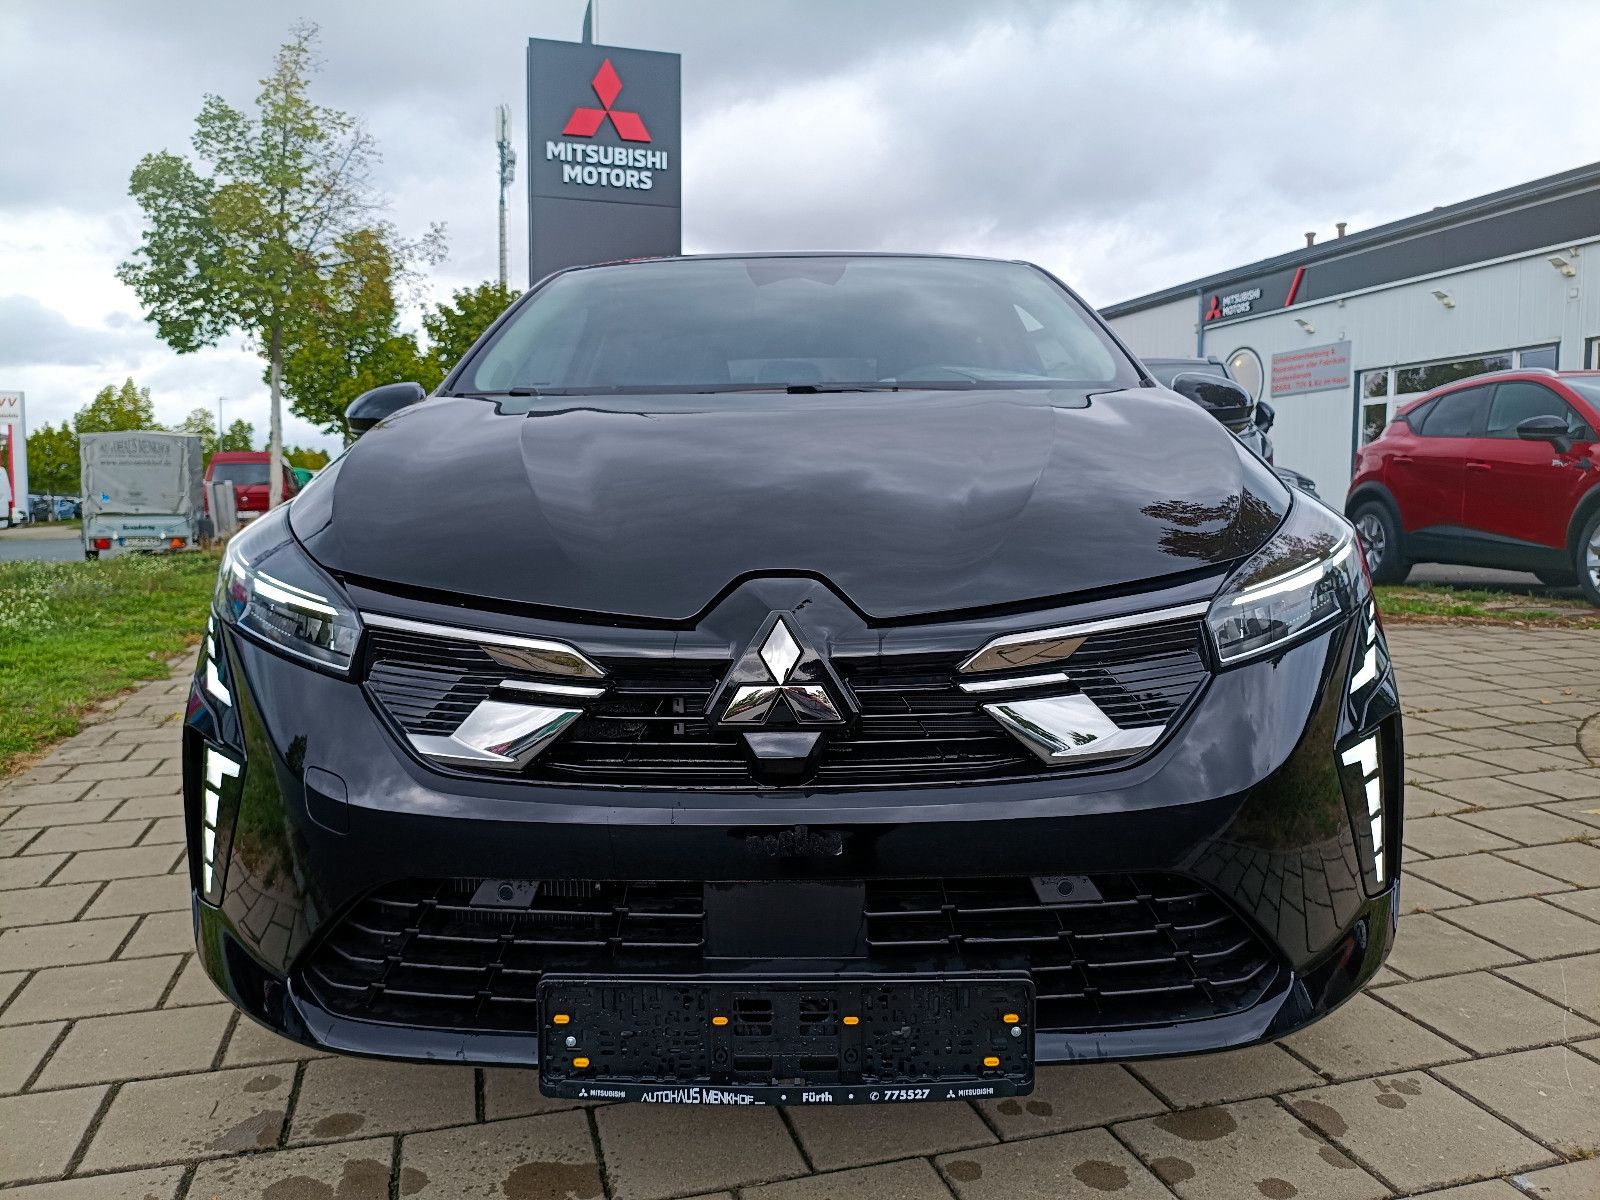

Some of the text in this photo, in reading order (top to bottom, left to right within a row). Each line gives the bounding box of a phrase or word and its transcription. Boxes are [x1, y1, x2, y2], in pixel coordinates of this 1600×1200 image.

[545, 140, 668, 170] MITSUBISHI
[562, 163, 653, 190] MOTORS
[1222, 300, 1251, 317] MOTORS
[590, 1089, 626, 1098] MITSUBISHI
[641, 1087, 754, 1105] AUTOHAUS MENKHOF
[802, 1091, 833, 1103] Fürth
[884, 1088, 931, 1101] 775527
[958, 1087, 994, 1098] MITSUBISHI
